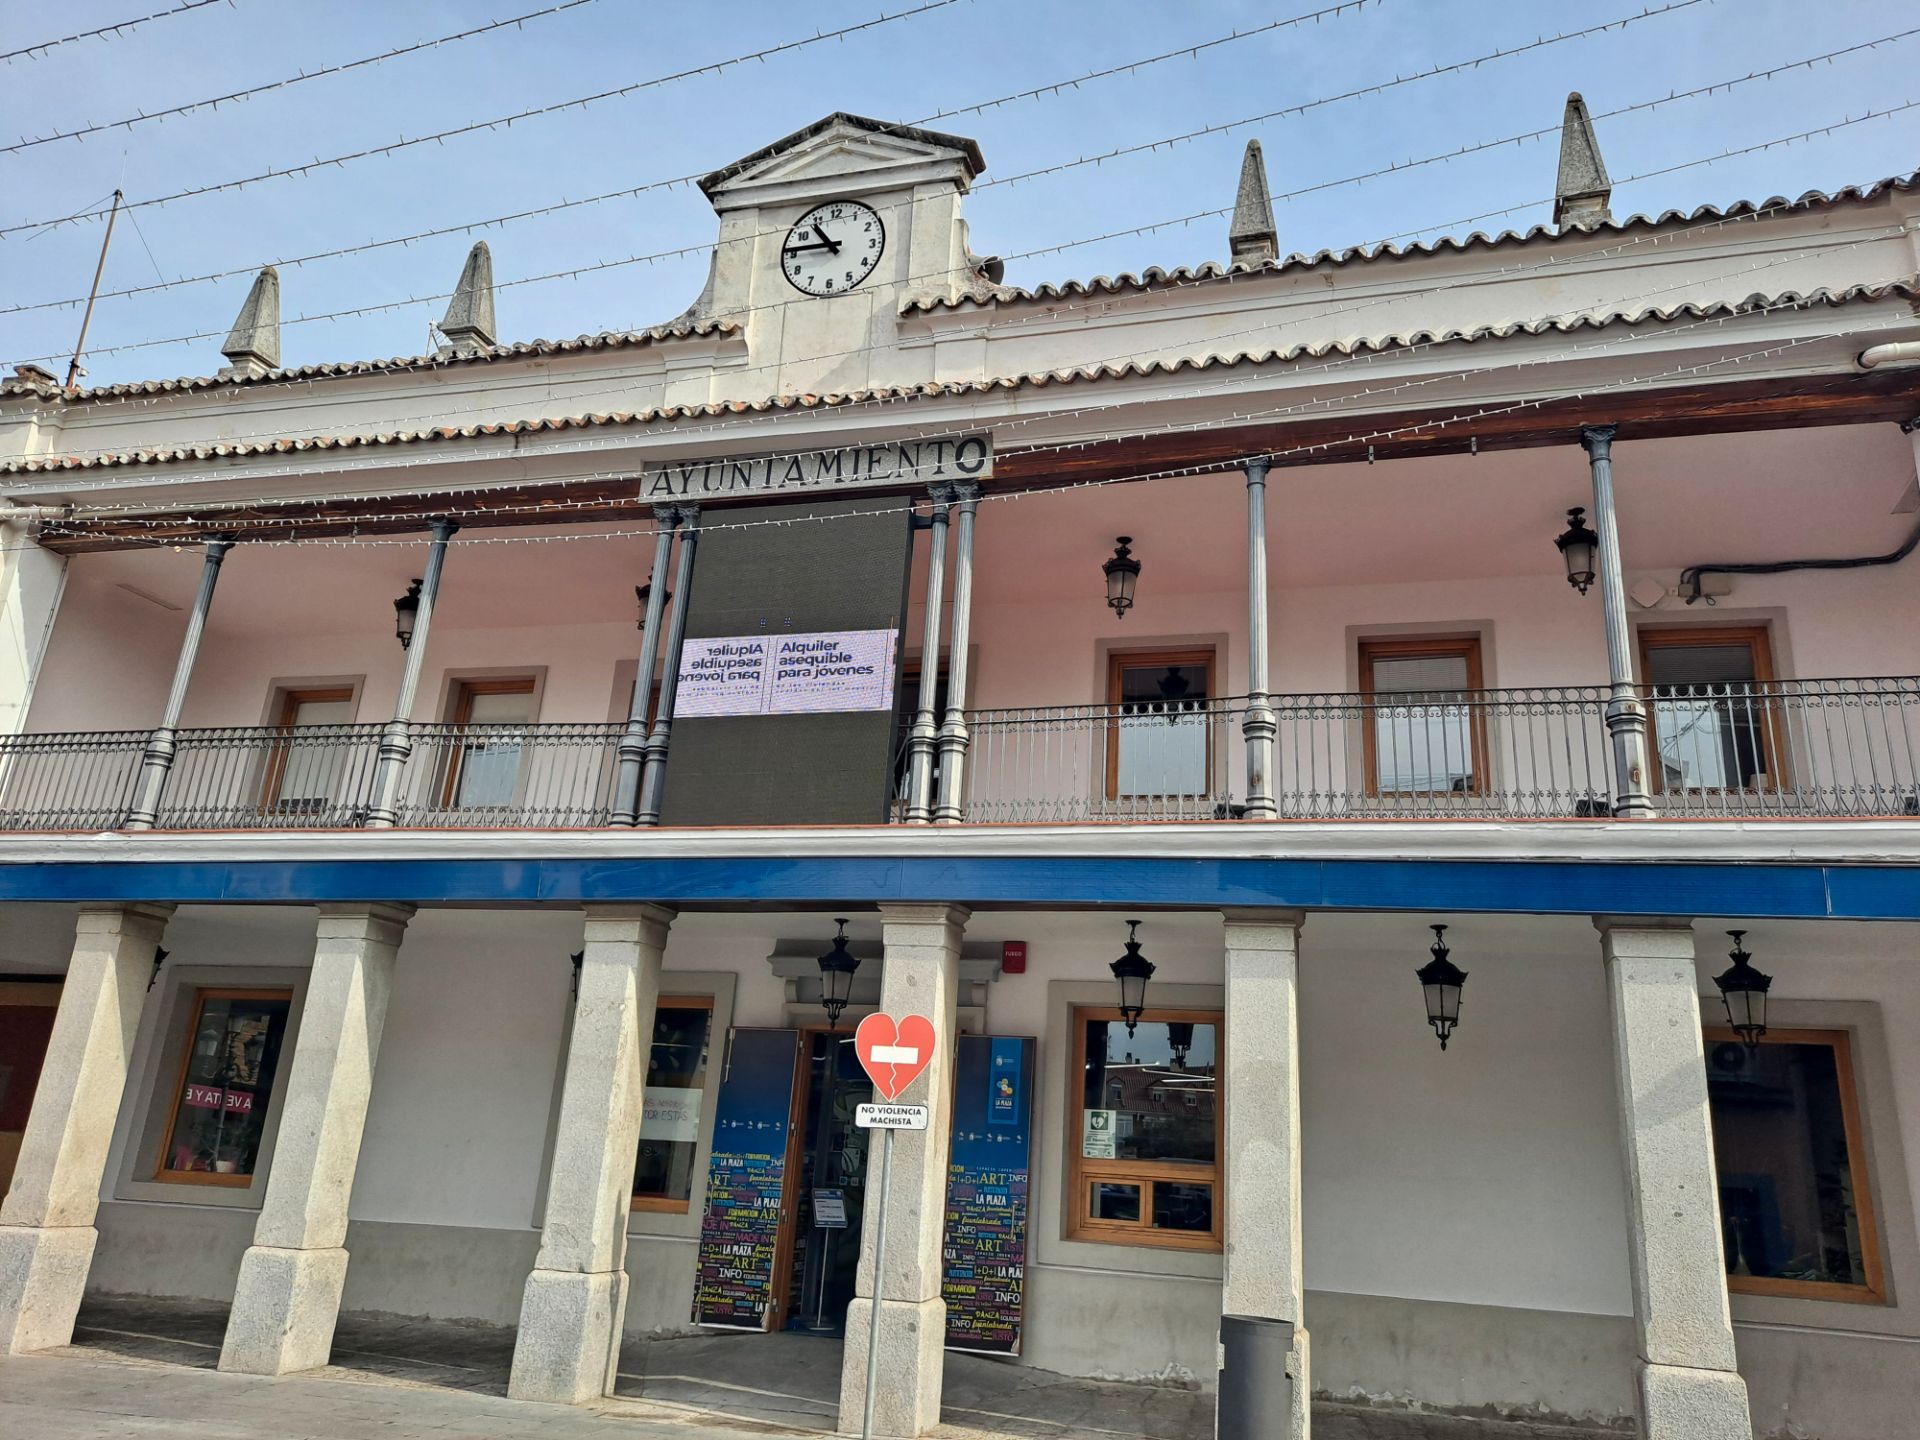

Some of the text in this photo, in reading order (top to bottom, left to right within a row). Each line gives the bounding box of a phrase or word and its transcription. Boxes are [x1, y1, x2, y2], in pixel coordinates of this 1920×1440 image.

[831, 209, 842, 219] 12
[852, 211, 858, 221] 1
[864, 222, 872, 232] 2
[797, 231, 809, 241] 10
[868, 239, 876, 249] 3
[861, 257, 869, 267] 4
[794, 265, 801, 275] 8
[807, 276, 814, 286] 7
[845, 272, 853, 282] 5
[826, 279, 833, 289] 6
[649, 437, 987, 496] AYUNTAMIENTO
[780, 640, 839, 655] Alquiler
[779, 652, 853, 666] asequible
[777, 665, 874, 680] para jóvenes
[861, 1106, 922, 1116] NO VIOLENCIA
[870, 1117, 912, 1126] MACHISTA
[720, 1158, 726, 1166] LA
[727, 1159, 744, 1167] PLAZA
[980, 1172, 1006, 1185] ART
[1008, 1174, 1027, 1183] INFO
[754, 1198, 762, 1207] LA
[976, 1194, 1006, 1206] LA PLAZA
[957, 1225, 976, 1234] INFO
[723, 1244, 752, 1256] LA PLAZA
[976, 1240, 1003, 1251] ART
[732, 1258, 758, 1270] ART
[719, 1268, 742, 1279] INFO
[974, 1266, 996, 1275] I+D+I
[998, 1266, 1006, 1277] LA
[995, 1291, 1020, 1304] INFO
[975, 1311, 999, 1319] DANZA
[951, 1318, 971, 1328] INFO
[972, 1320, 1013, 1330] fuenlabrada
